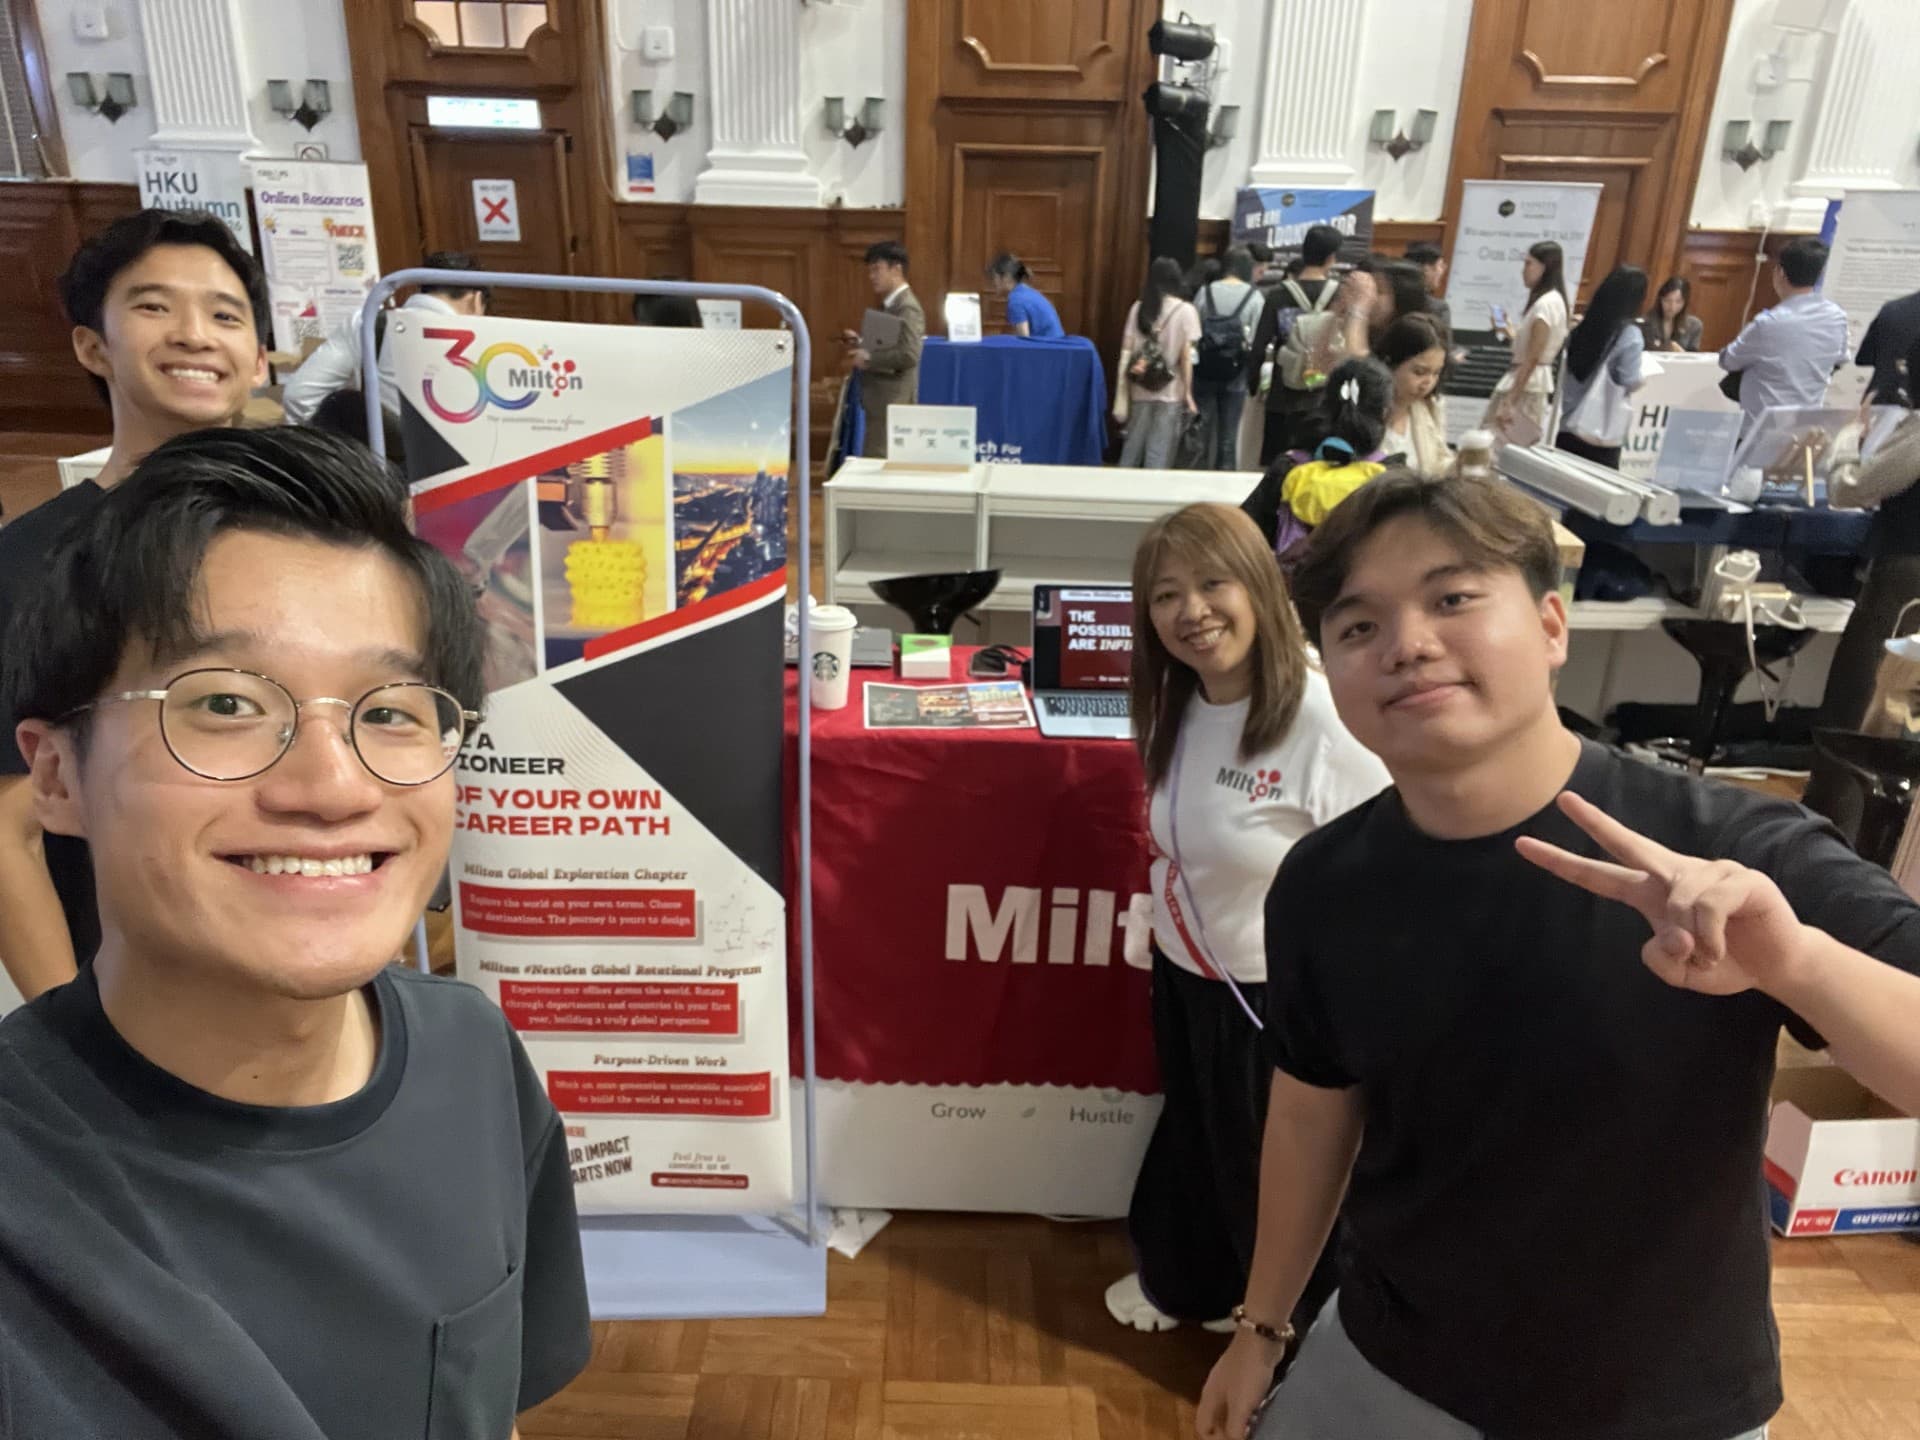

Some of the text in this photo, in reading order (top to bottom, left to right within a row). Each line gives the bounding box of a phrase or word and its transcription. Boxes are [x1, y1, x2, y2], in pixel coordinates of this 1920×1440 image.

[146, 171, 198, 194] HKU
[260, 190, 365, 208] Online Resources
[508, 363, 584, 393] Milton
[1068, 609, 1096, 622] THE
[1068, 638, 1096, 650] ARE
[477, 732, 495, 750] A
[1216, 765, 1283, 803] Milton
[488, 788, 580, 810] YOUR
[587, 789, 662, 810] OWN
[579, 815, 671, 836] PATH
[464, 862, 688, 882] Milton Global Exploration Chapter
[504, 898, 520, 908] the
[523, 898, 550, 908] world
[568, 900, 590, 910] your
[547, 913, 567, 924] The
[568, 914, 606, 926] journey
[479, 959, 762, 979] Milton #NextGen Global Rotational Program
[511, 984, 561, 996] Experience
[562, 987, 580, 995] our
[645, 986, 662, 995] the
[505, 1000, 544, 1011] through
[546, 1000, 605, 1011] departments
[607, 1001, 626, 1010] and
[627, 1001, 672, 1010] countries
[687, 1002, 709, 1012] your
[554, 1014, 593, 1026] building
[603, 1015, 628, 1026] truly
[631, 1015, 658, 1026] global
[593, 1053, 728, 1067] Purpose-Driven Work
[590, 1095, 615, 1105] build
[616, 1095, 633, 1105] the
[635, 1095, 661, 1105] world
[931, 1102, 1135, 1125] Grow Hustle
[584, 1136, 631, 1162] IMPACT
[604, 1156, 633, 1178] NOW
[1833, 1168, 1918, 1186] Canon
